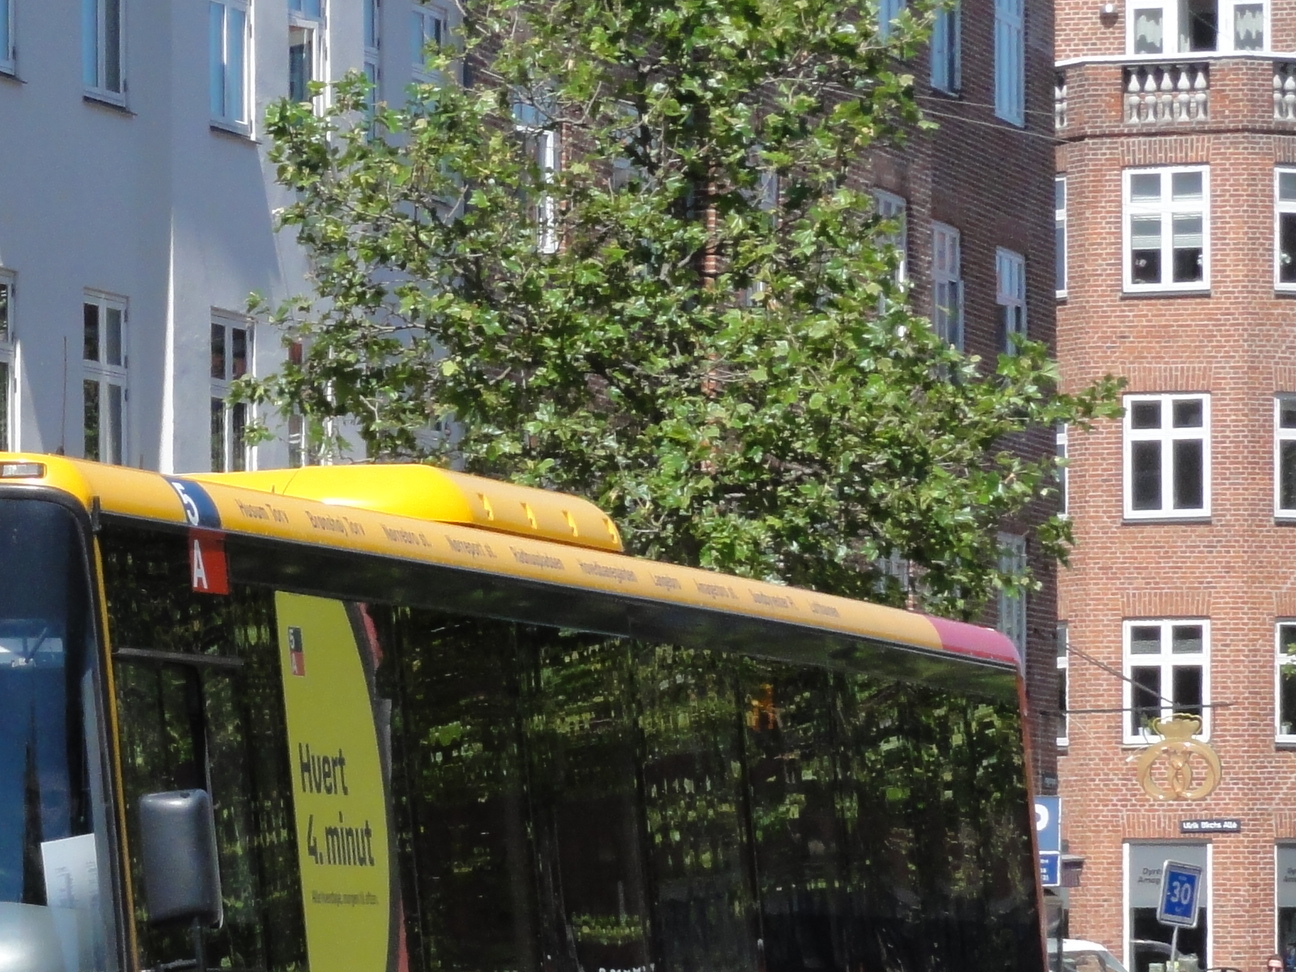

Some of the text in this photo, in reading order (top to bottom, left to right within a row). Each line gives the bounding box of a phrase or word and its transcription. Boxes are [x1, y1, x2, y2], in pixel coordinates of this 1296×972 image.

[172, 482, 199, 526] 5
[192, 539, 207, 589] A
[299, 742, 349, 796] Hvert
[306, 810, 375, 867] 4. minut
[1170, 881, 1191, 905] 30
